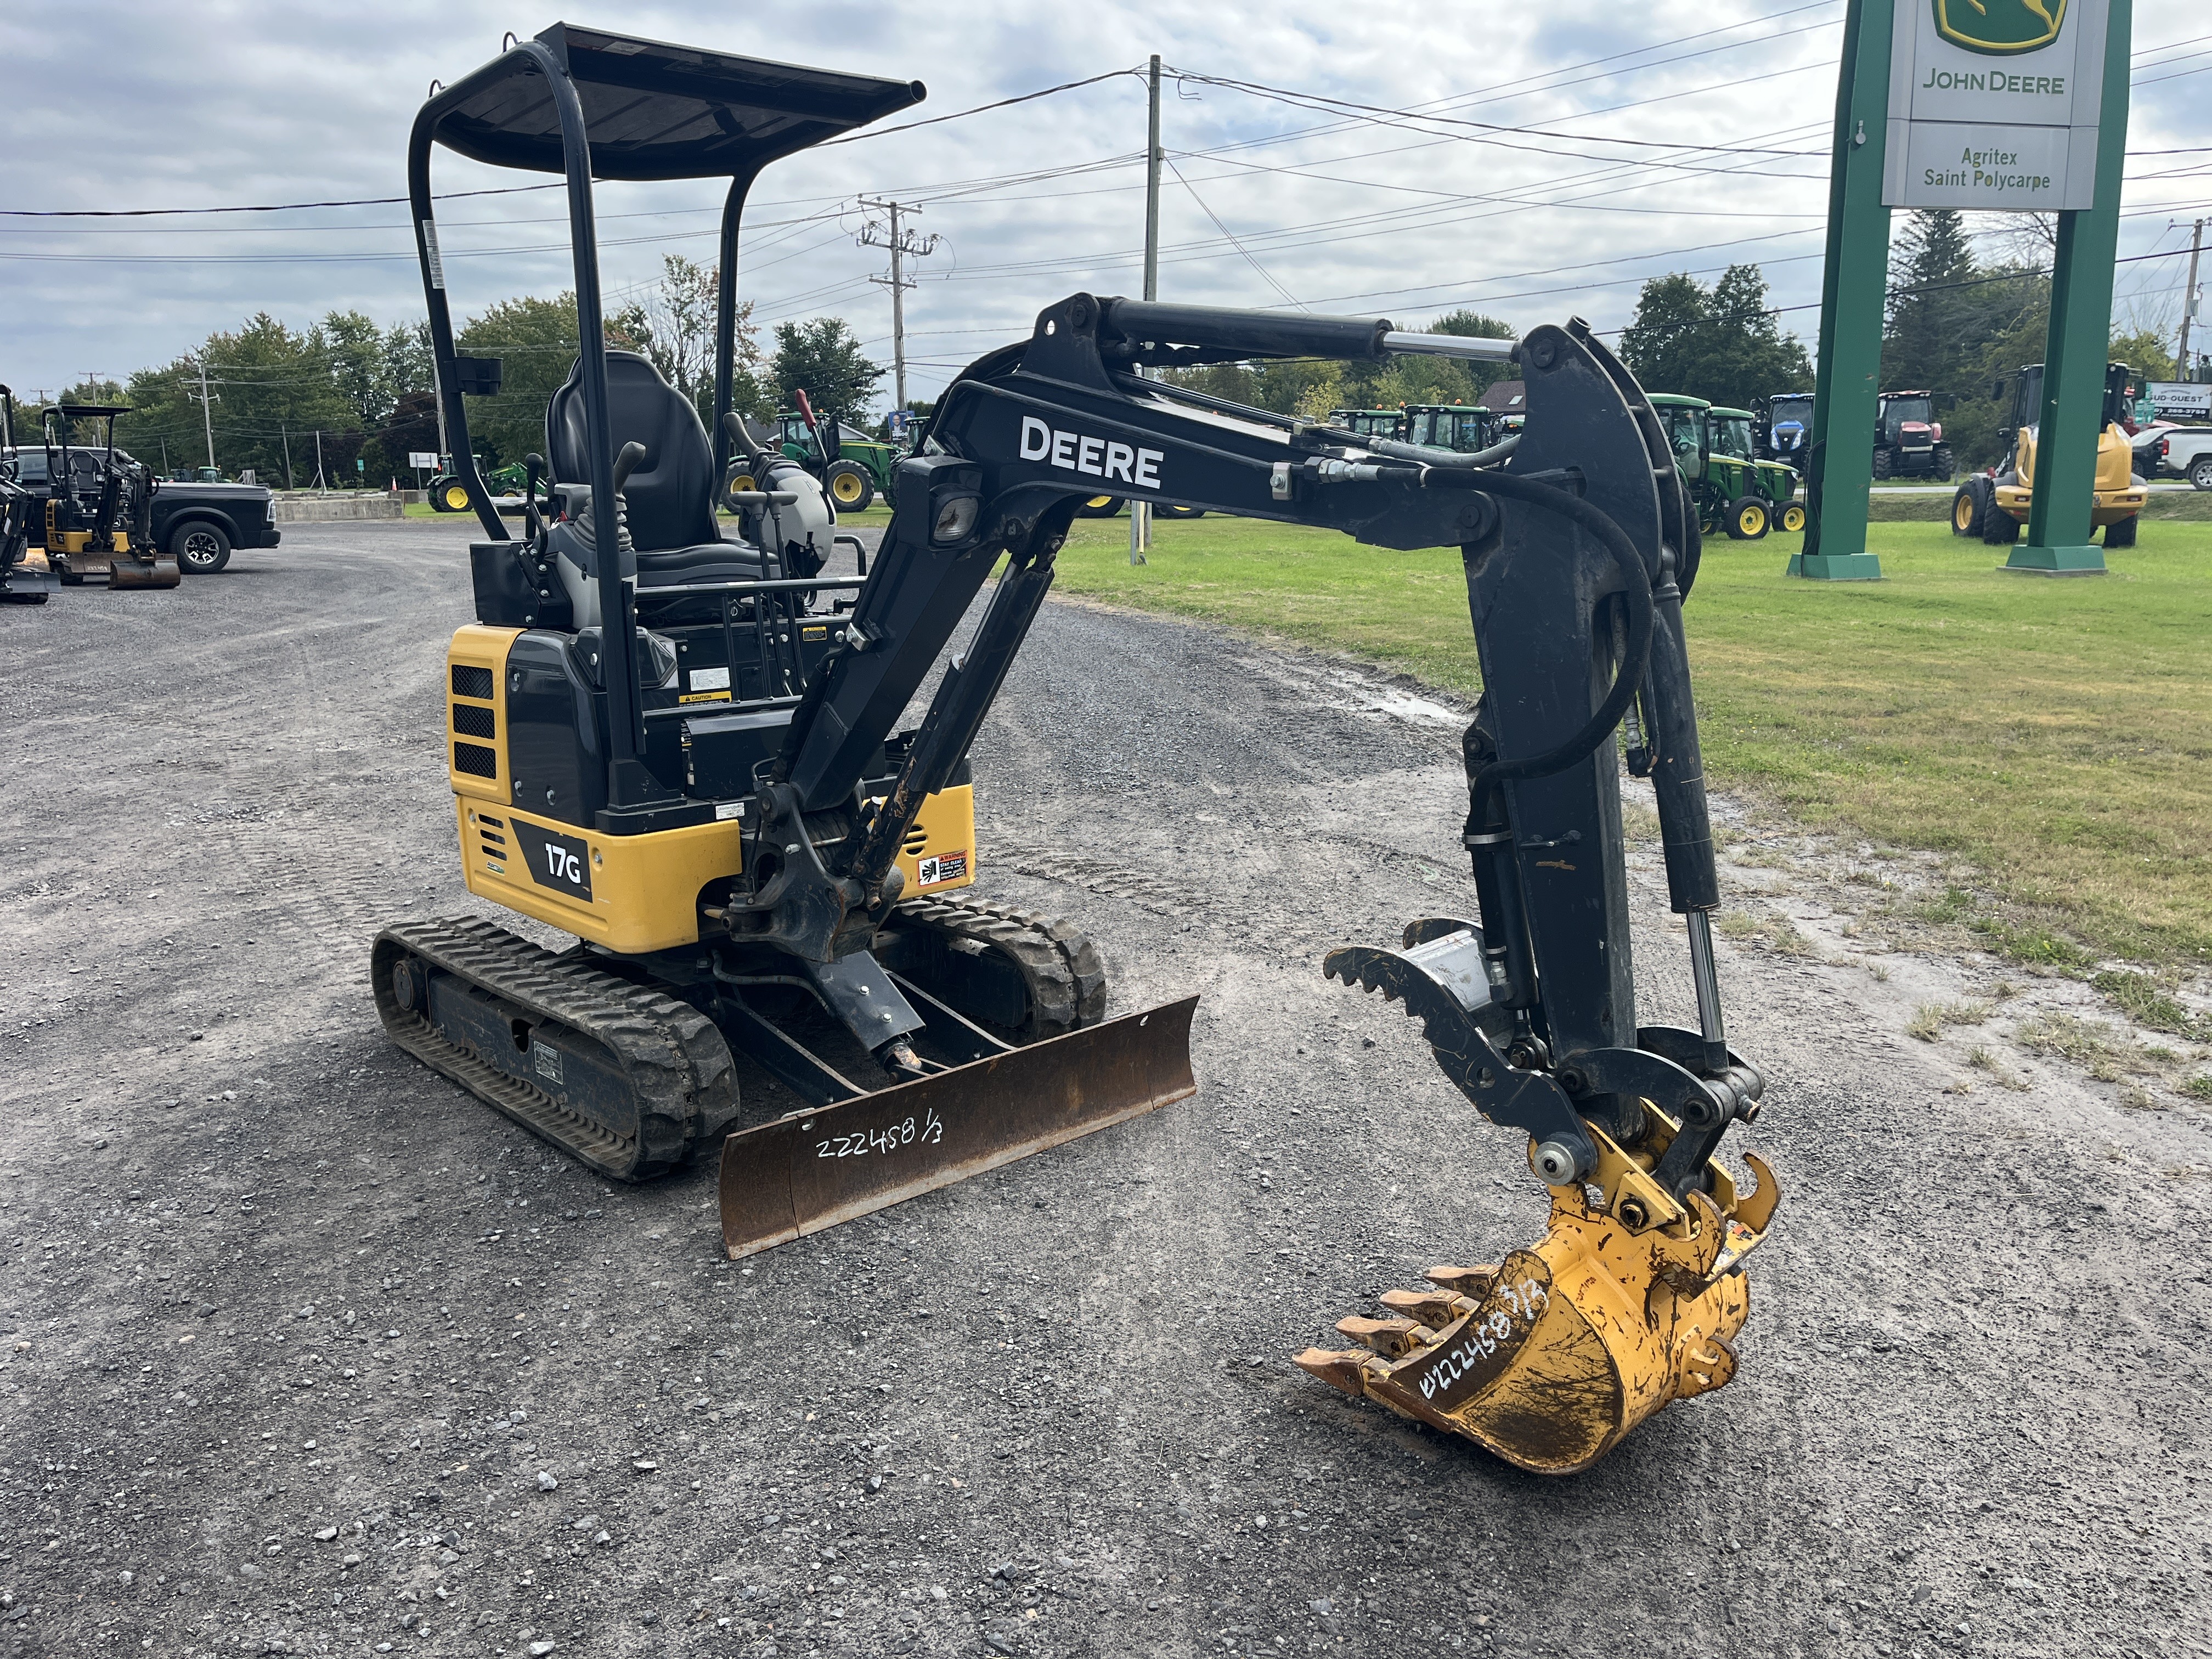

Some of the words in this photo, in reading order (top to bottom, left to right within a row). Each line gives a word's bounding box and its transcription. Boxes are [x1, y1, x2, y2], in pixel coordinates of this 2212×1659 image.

[1923, 68, 1985, 91] JOHN
[1990, 71, 2065, 95] DEERE
[1961, 147, 2017, 167] Agritex
[1924, 169, 1967, 188] Saint
[1973, 171, 2051, 192] Polycarpe
[1019, 415, 1164, 489] DEERE
[545, 843, 582, 884] 17G
[944, 851, 966, 860] WARNING
[816, 1117, 915, 1158] 222458
